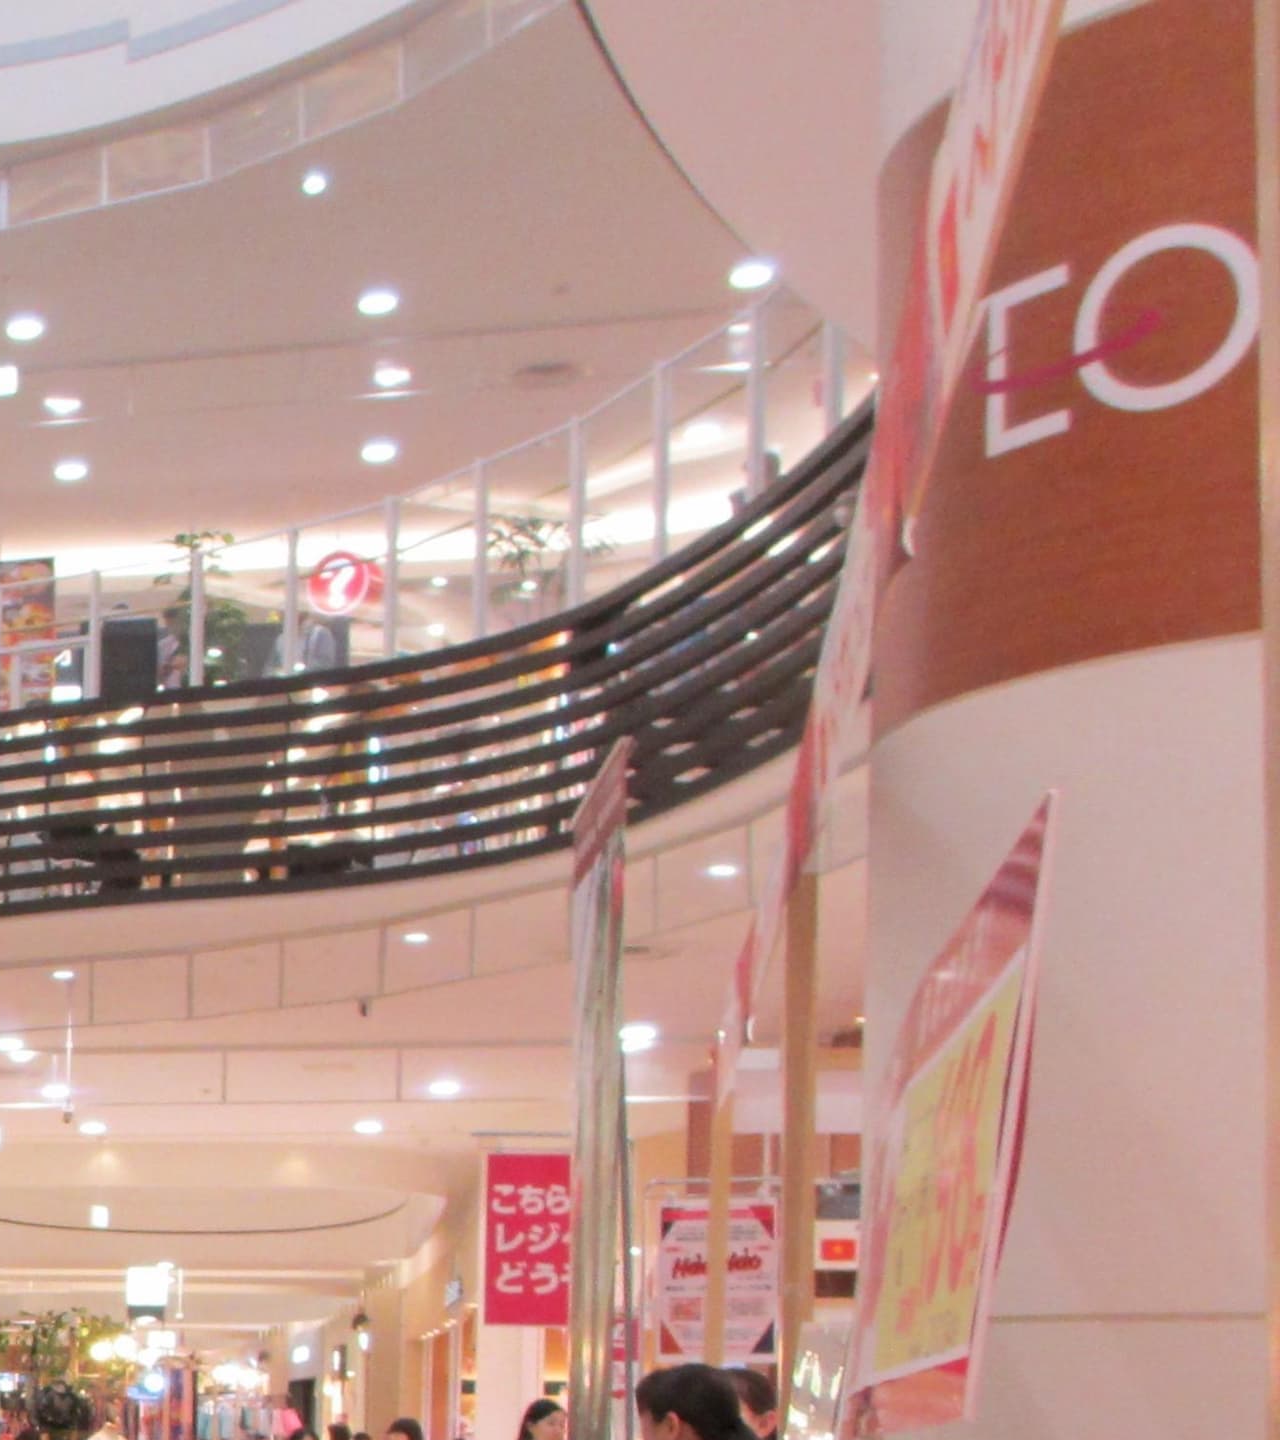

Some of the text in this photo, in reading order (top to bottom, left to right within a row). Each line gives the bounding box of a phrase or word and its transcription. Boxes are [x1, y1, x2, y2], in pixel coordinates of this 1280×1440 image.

[980, 223, 1259, 459] EO
[492, 1183, 571, 1215] こちら
